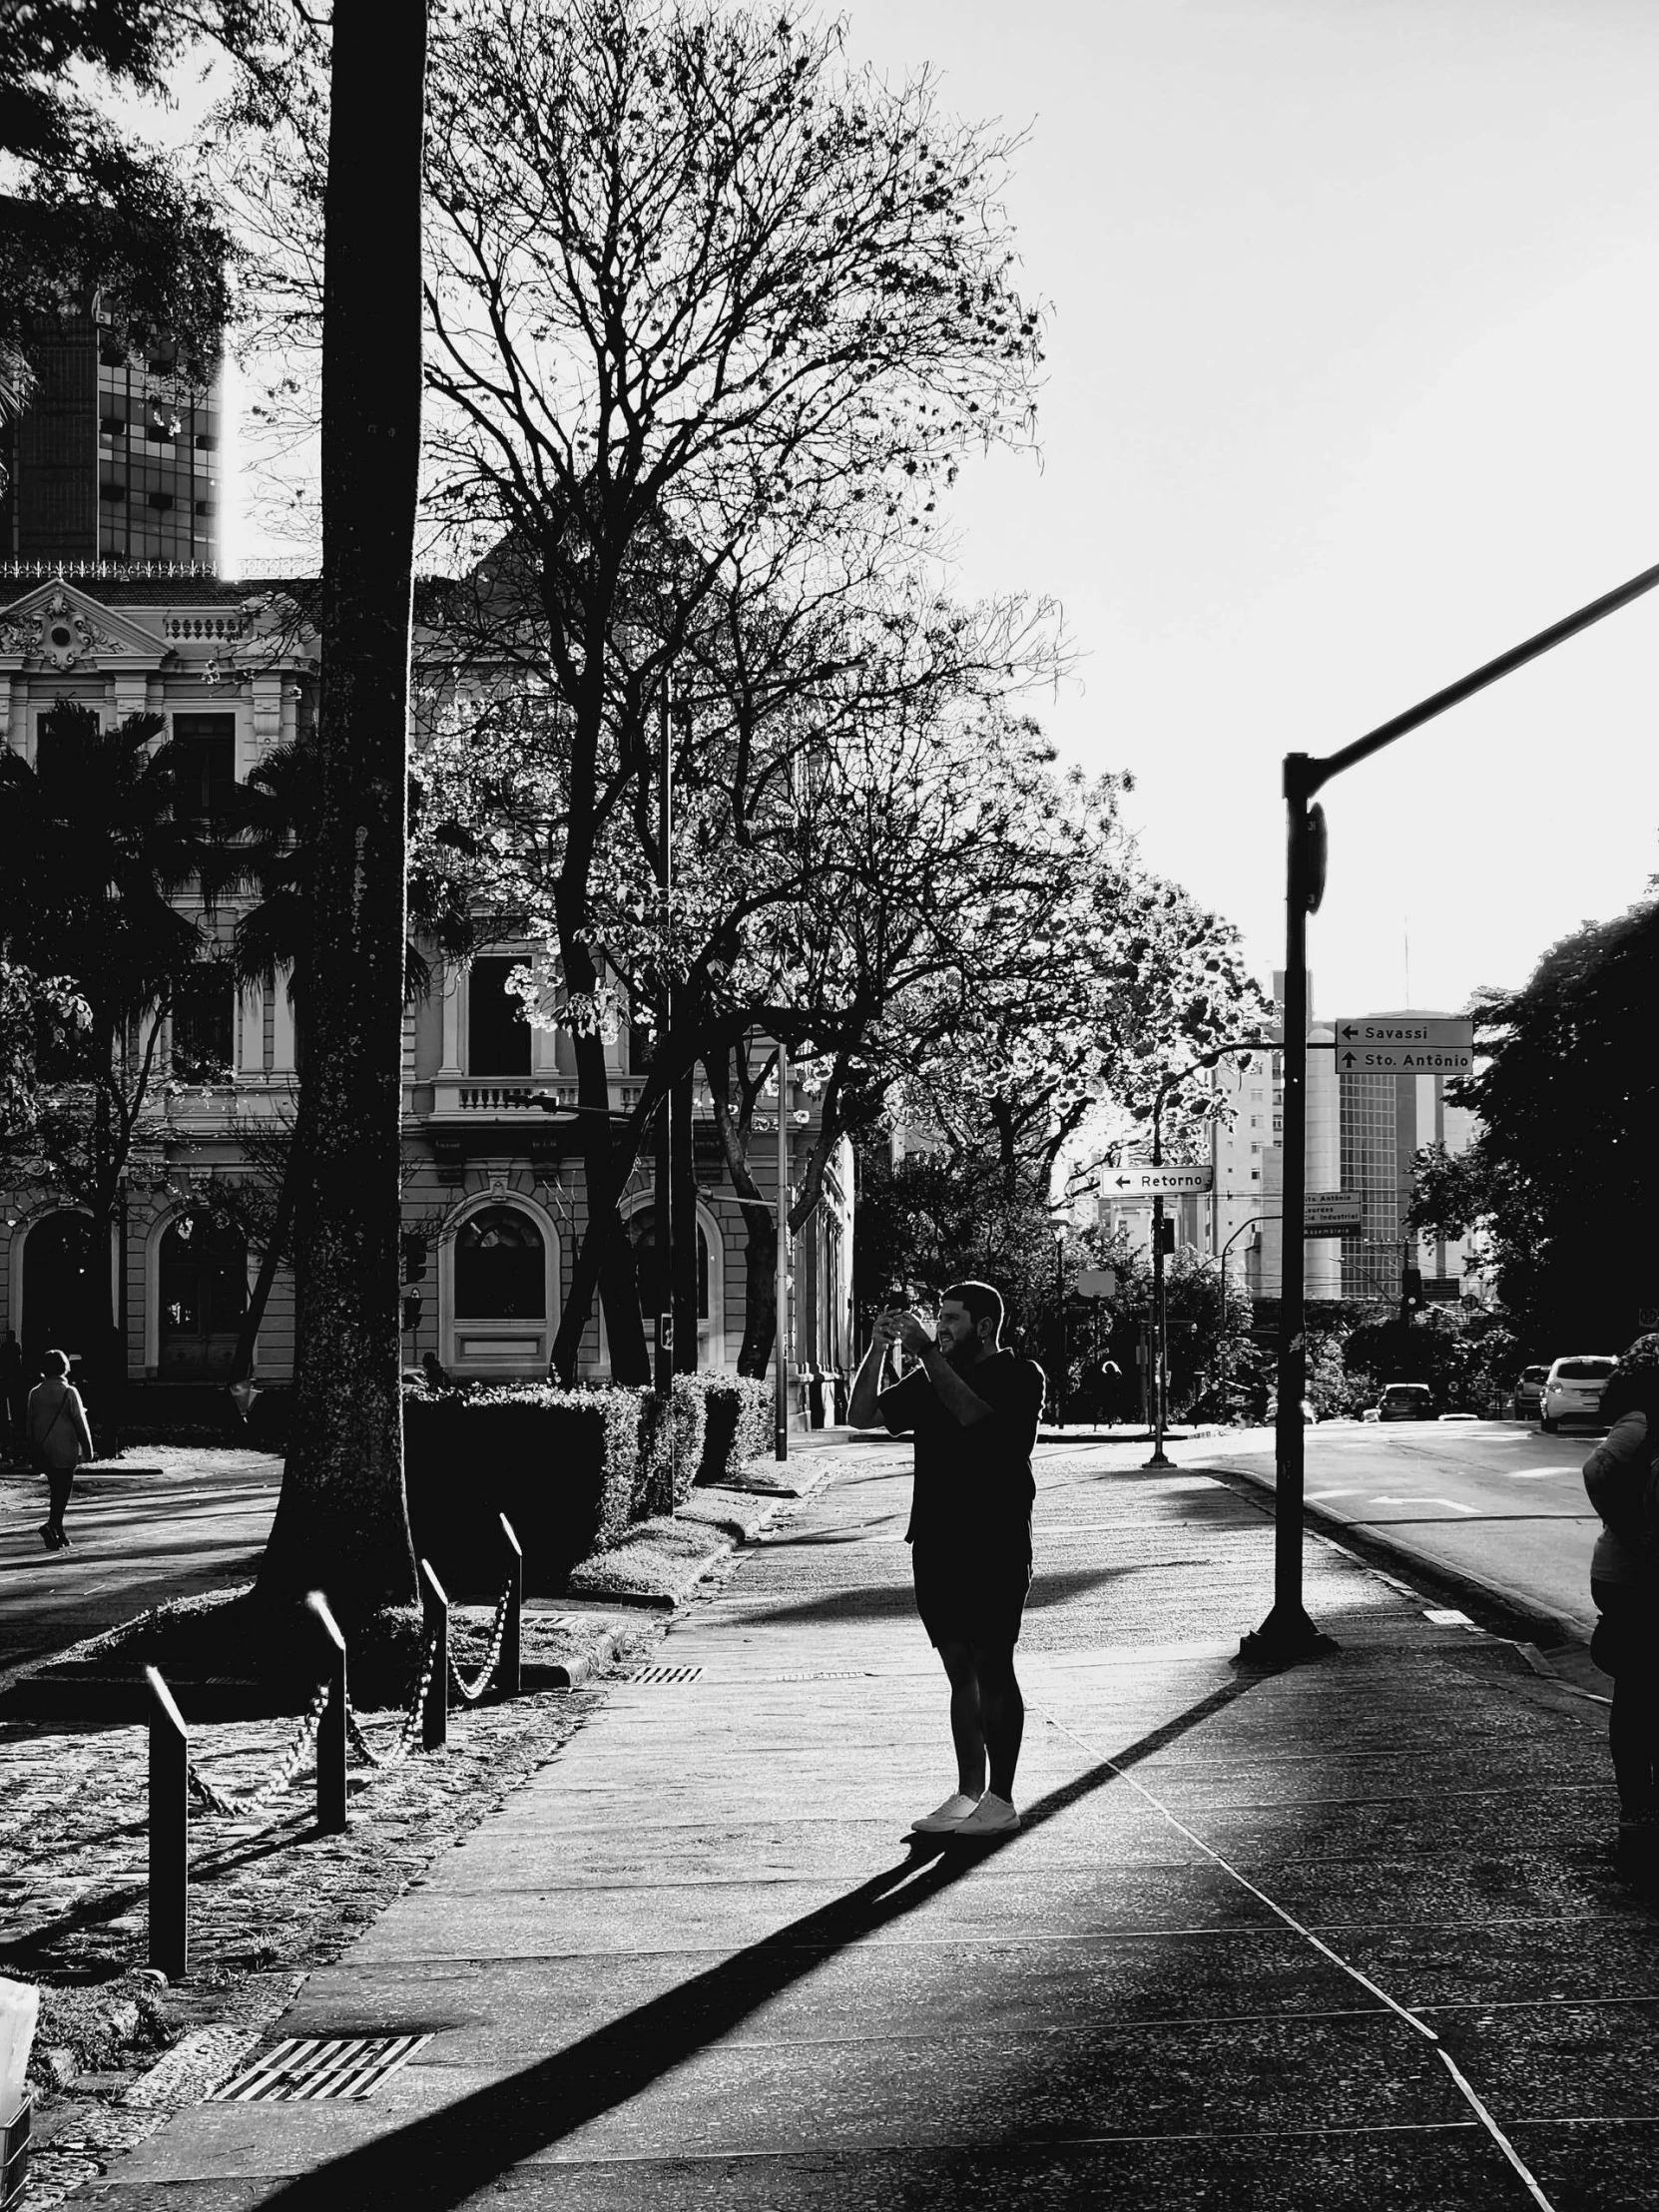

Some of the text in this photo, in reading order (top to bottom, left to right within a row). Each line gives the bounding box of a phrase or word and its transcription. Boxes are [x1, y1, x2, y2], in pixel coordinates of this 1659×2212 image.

[1365, 1026, 1428, 1039] Savassi
[1365, 1054, 1468, 1067] Sto. Antônio
[1141, 1175, 1202, 1187] Retorno
